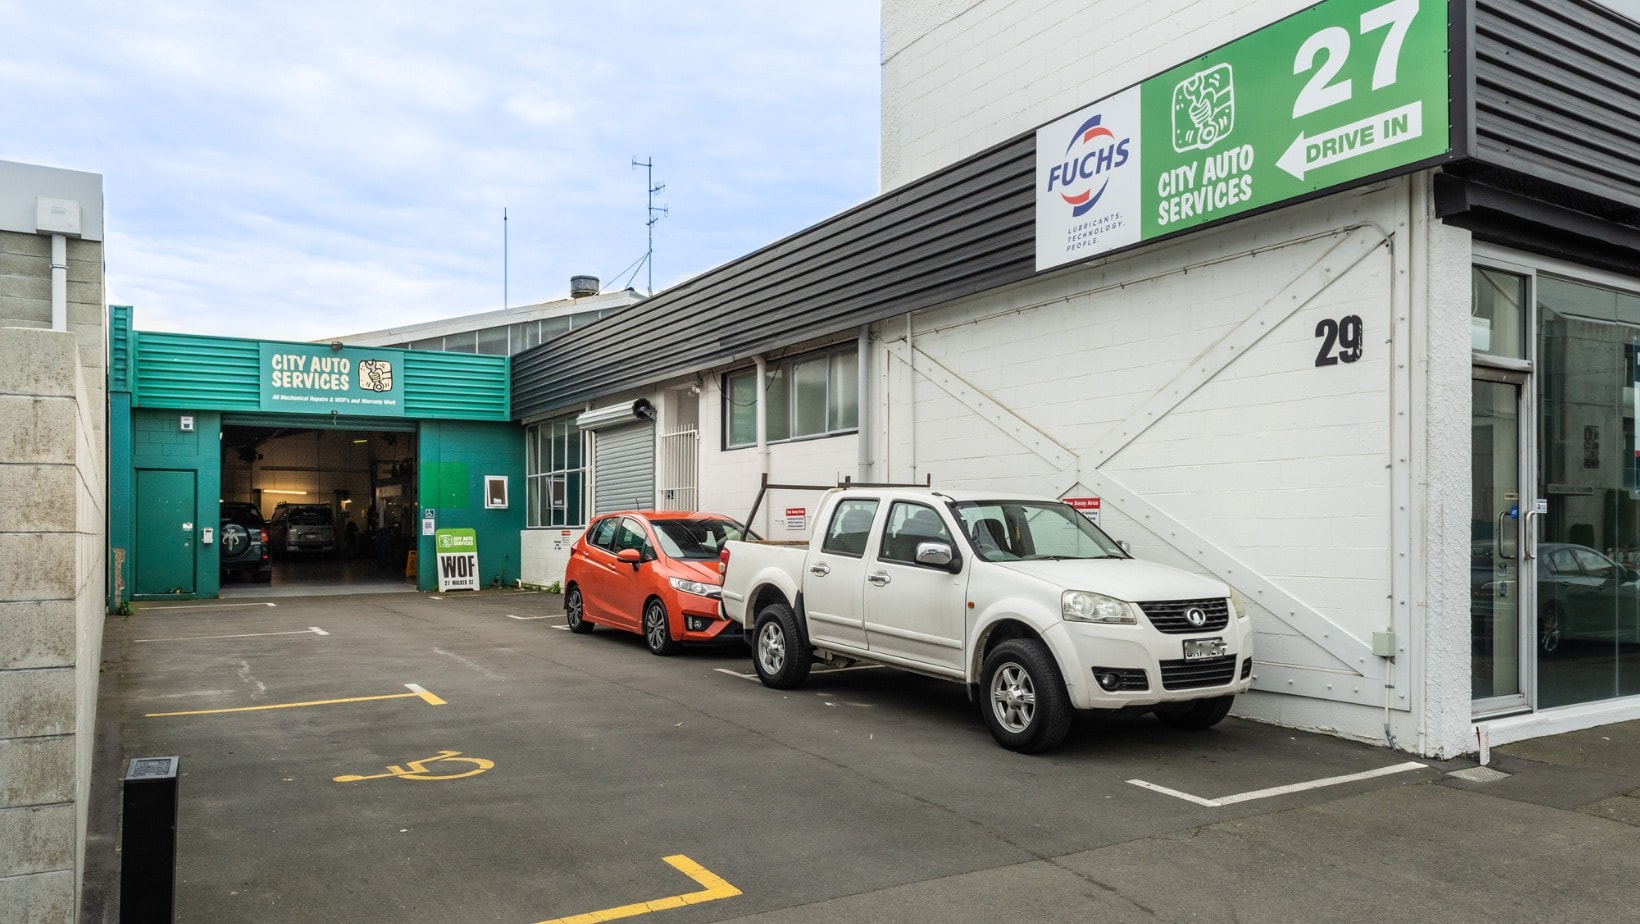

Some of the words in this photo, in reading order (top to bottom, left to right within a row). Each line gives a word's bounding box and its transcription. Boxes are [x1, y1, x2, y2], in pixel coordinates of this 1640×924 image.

[1292, 0, 1420, 119] 27
[1305, 124, 1375, 164] DRIVE
[1383, 113, 1408, 139] IN
[1047, 137, 1130, 192] FUCHS
[1158, 160, 1198, 198] CITY
[1202, 144, 1254, 185] AUTO
[1157, 174, 1253, 226] SERVICES
[1067, 221, 1126, 243] TECHNOLOGY.
[1068, 212, 1123, 235] LUBRICANTS.
[1066, 237, 1100, 252] PEOPLE.
[1315, 314, 1363, 368] 29
[271, 354, 306, 371] CITY
[310, 356, 351, 374] AUTO
[271, 371, 350, 391] SERVICES
[280, 394, 309, 402] Mechanical
[441, 555, 475, 578] WOF
